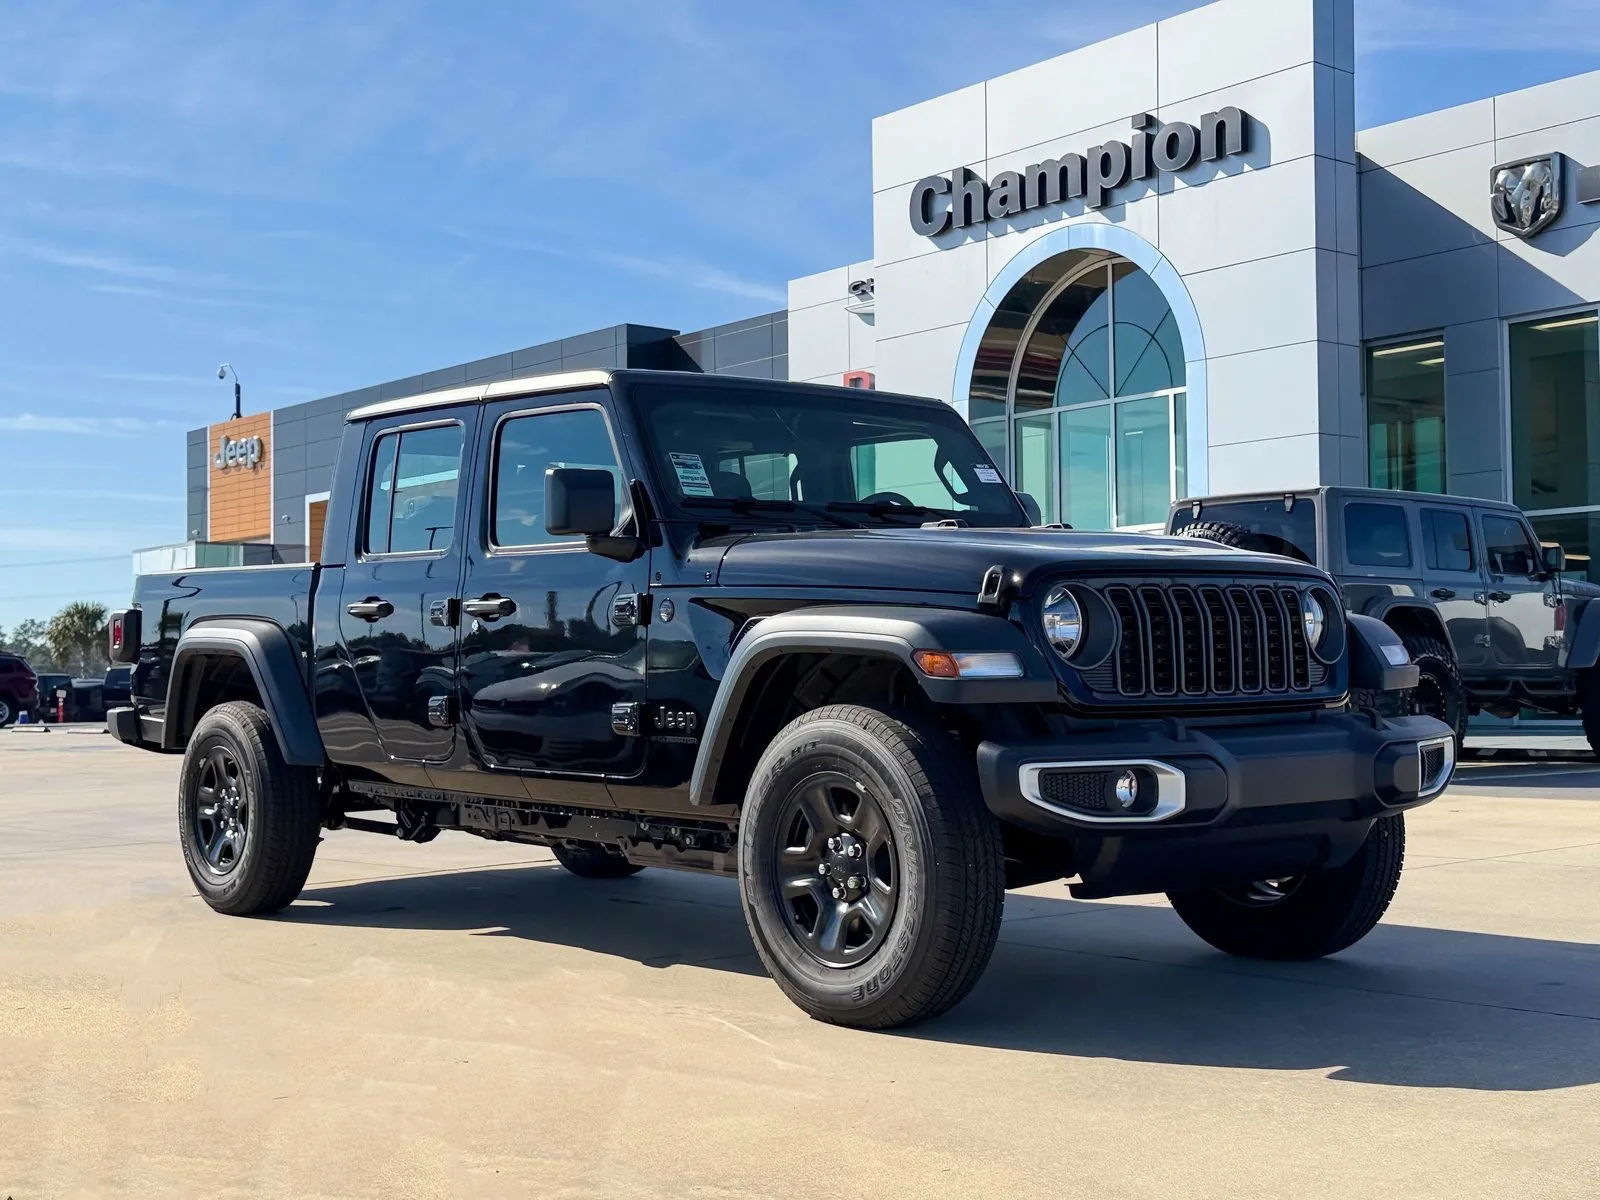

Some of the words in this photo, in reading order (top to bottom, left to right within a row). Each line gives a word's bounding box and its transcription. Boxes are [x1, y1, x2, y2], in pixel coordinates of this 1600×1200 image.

[909, 105, 1247, 237] Champion
[214, 435, 262, 470] Jeep
[654, 706, 697, 734] Jeep
[851, 797, 919, 1003] BRIDGESTONE
